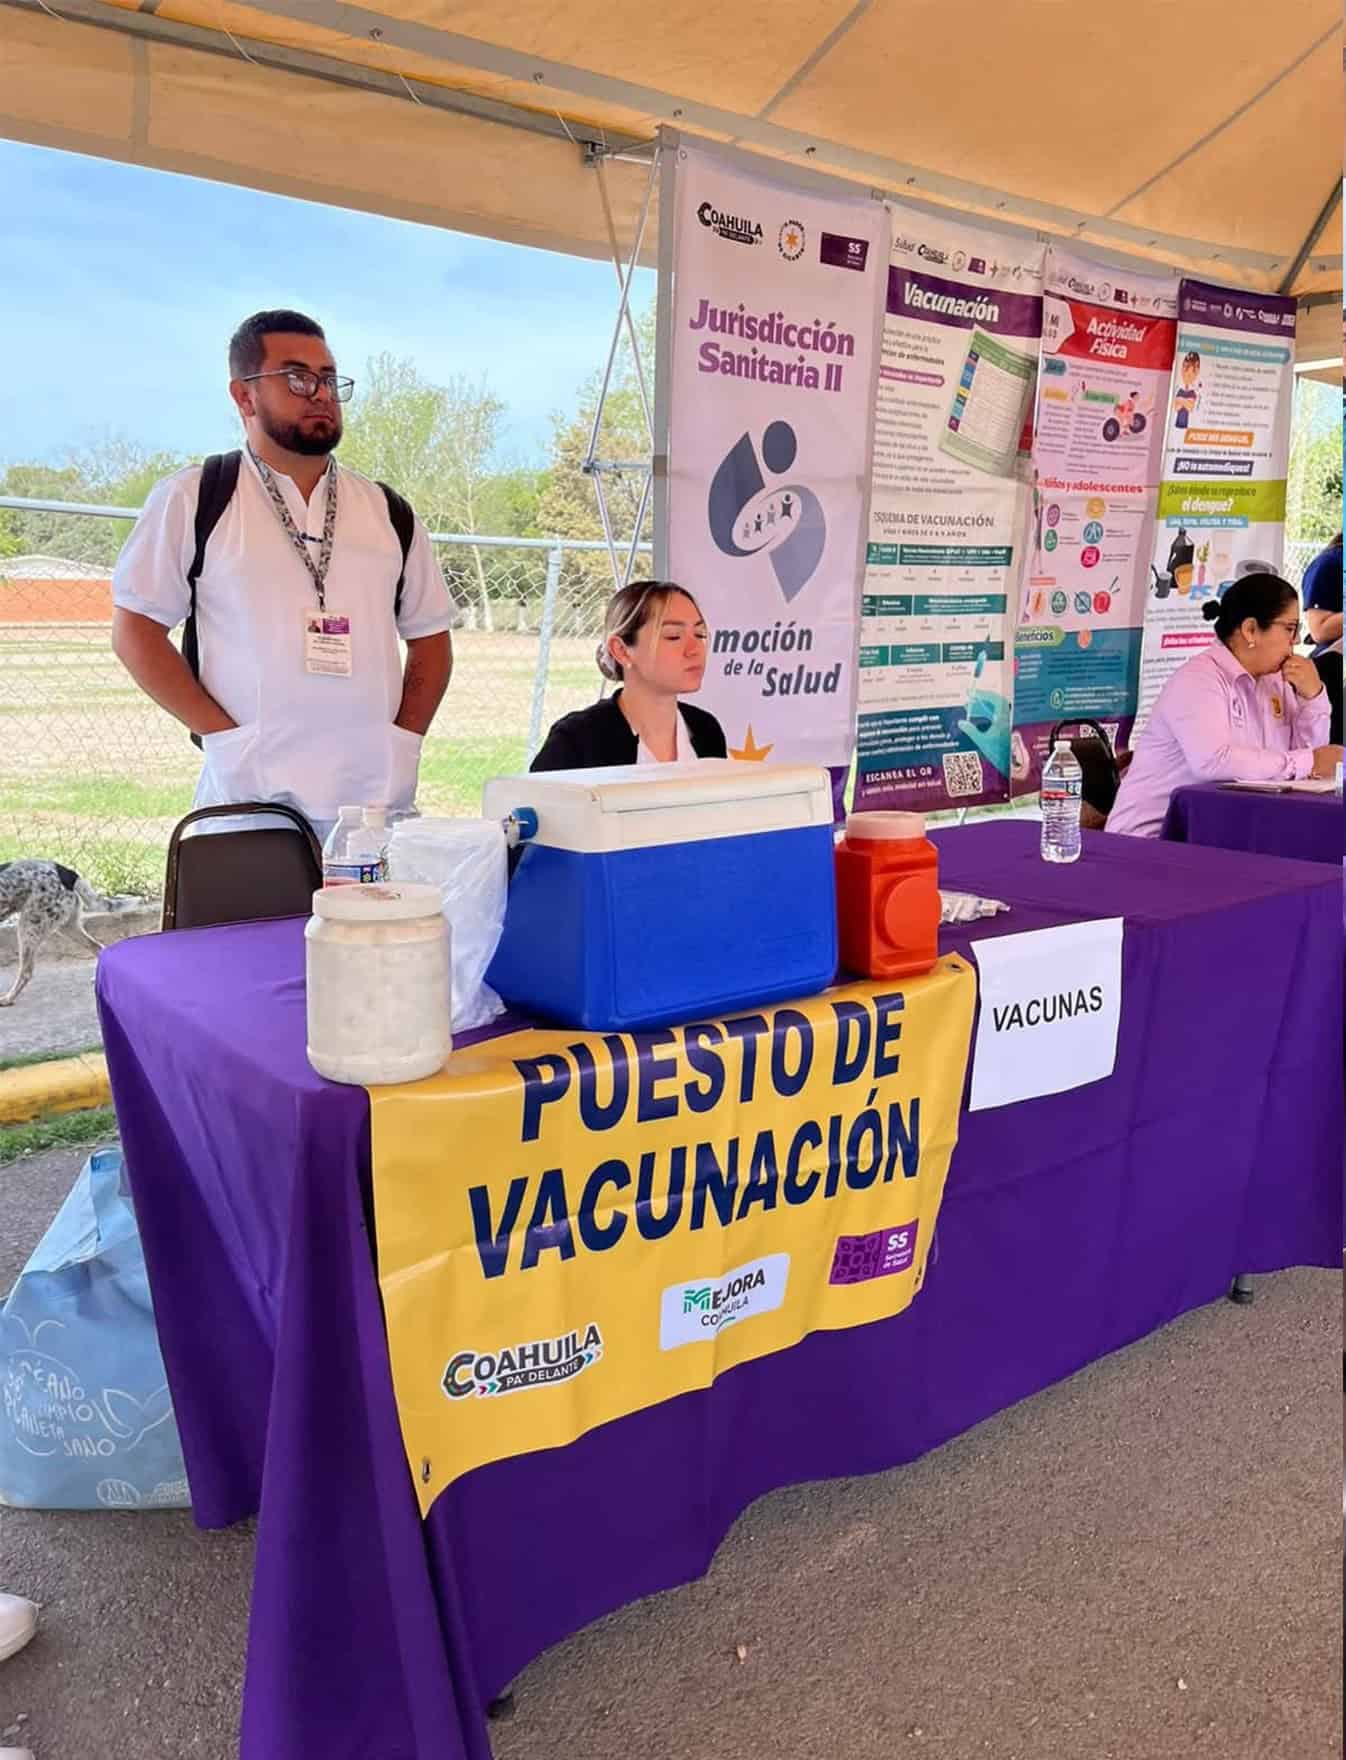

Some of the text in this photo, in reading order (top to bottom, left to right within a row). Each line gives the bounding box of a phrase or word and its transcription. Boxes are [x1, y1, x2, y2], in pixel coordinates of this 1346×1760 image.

[697, 202, 763, 238] COAHUILA
[848, 242, 861, 254] SS
[903, 280, 999, 323] Vacunación
[689, 298, 855, 357] Jurisdicción
[1087, 316, 1147, 343] Actividad
[1089, 337, 1128, 359] Física
[698, 341, 820, 390] Sanitaria
[824, 364, 842, 393] II
[1071, 480, 1143, 493] adolescentes
[907, 512, 920, 525] DE
[920, 514, 995, 527] VACUNACIÓN
[713, 621, 812, 653] moción
[724, 659, 765, 675] de la
[762, 663, 842, 697] Salud
[993, 985, 1103, 1033] VACUNAS
[512, 991, 905, 1143] PUESTO DE
[468, 1086, 921, 1281] VACUNACIÓN
[887, 1230, 909, 1251] SS
[683, 1267, 765, 1314] MEJORA
[701, 1295, 749, 1327] COHUILA
[443, 1324, 602, 1397] COAHUILA
[506, 1358, 579, 1387] PA' DELANTE
